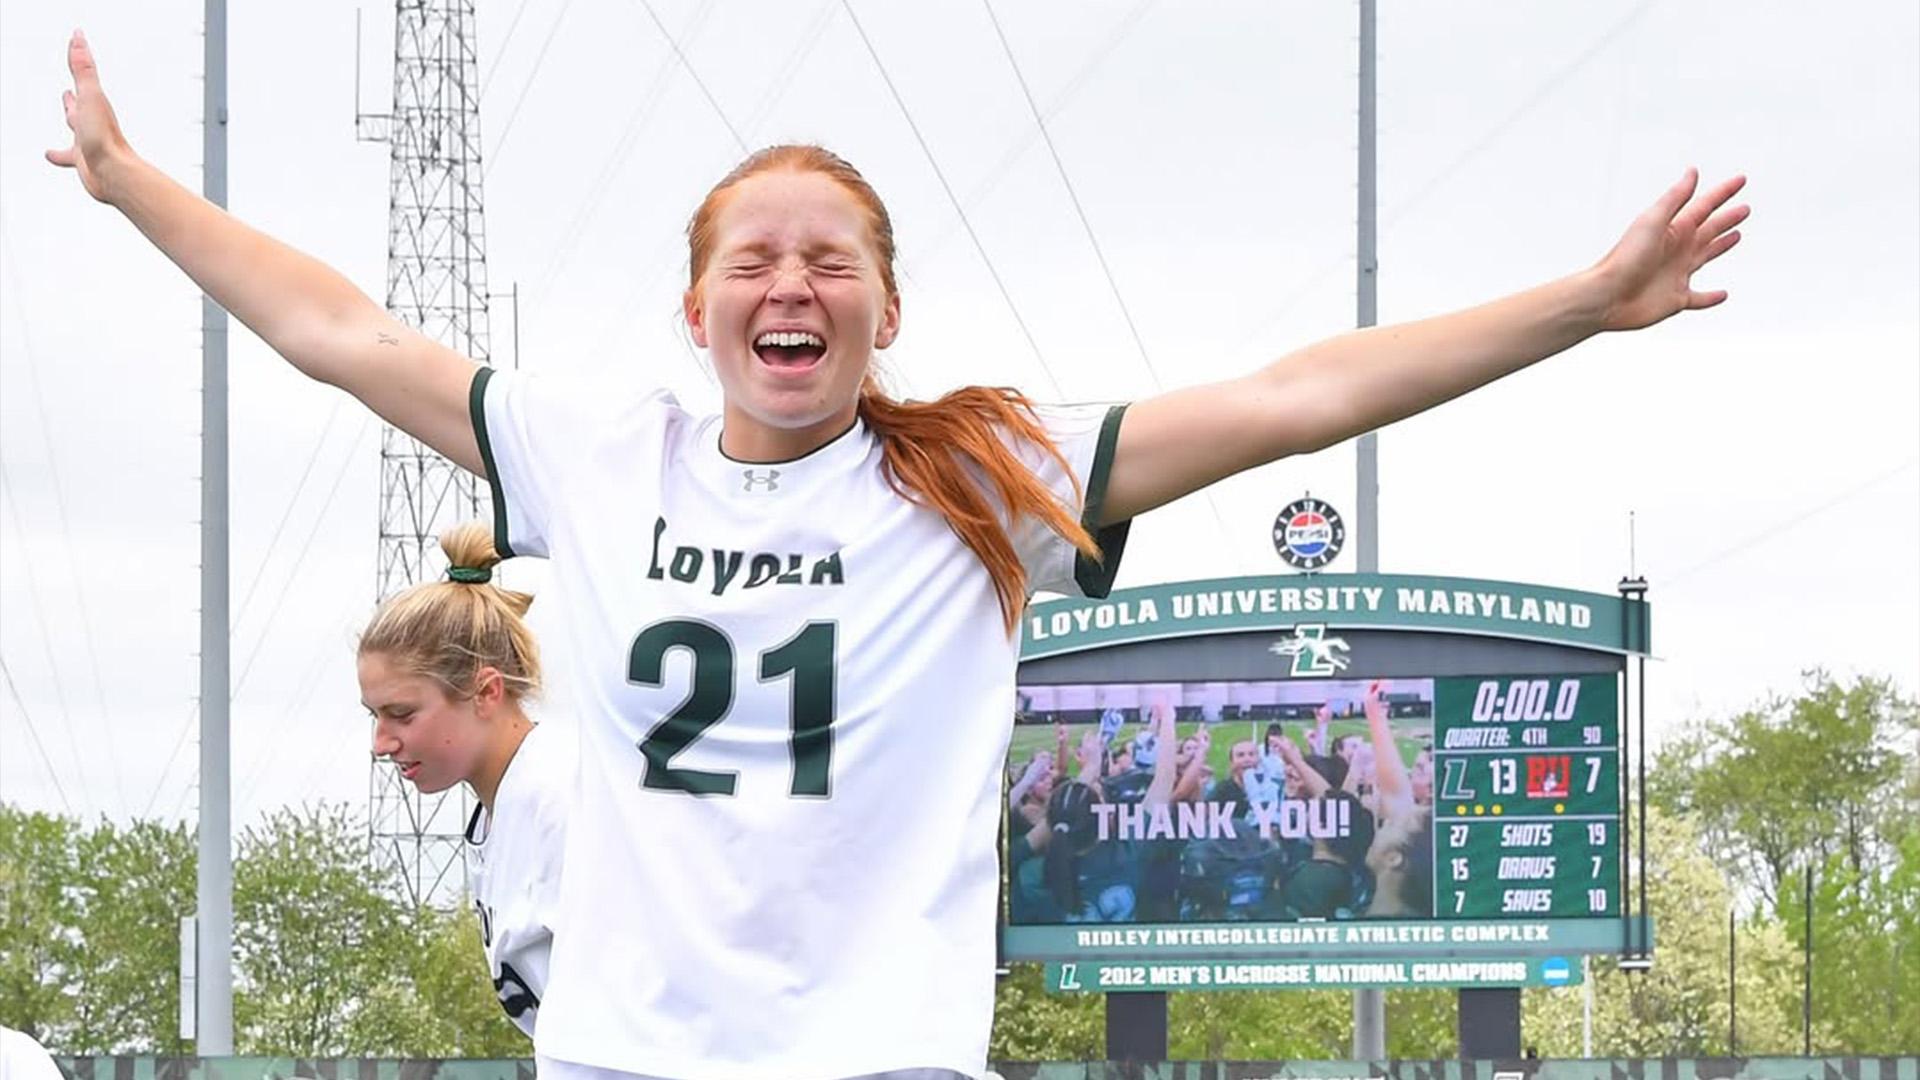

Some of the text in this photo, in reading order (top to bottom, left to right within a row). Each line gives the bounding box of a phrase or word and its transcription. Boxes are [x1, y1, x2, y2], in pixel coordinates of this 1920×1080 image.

[1288, 529, 1329, 539] PESI
[1031, 586, 1592, 641] LOYOLA UNIVERSITY MARYLAND
[625, 615, 839, 801] 21
[1471, 679, 1580, 722] 0:00.0
[1444, 727, 1511, 748] QUARTER:
[1521, 727, 1548, 745] 4TH
[1488, 758, 1517, 795] 13
[1585, 757, 1602, 793] 7
[1090, 800, 1351, 840] THANK YOU!
[1450, 823, 1606, 847] 27 SHOTS 19
[1451, 856, 1602, 880] 15 DRAWS 7
[1454, 889, 1607, 914] 7 SAVES 10
[1078, 925, 1549, 946] RIDLEY INTERCOLLEGIATE ATHLETIC COMPLEX
[1099, 967, 1146, 985] 2012
[1150, 966, 1211, 984] MEN'S
[1215, 965, 1309, 984] LACROSSE
[1315, 964, 1408, 983] NATIONAL
[1411, 962, 1527, 982] CHAMPIONS
